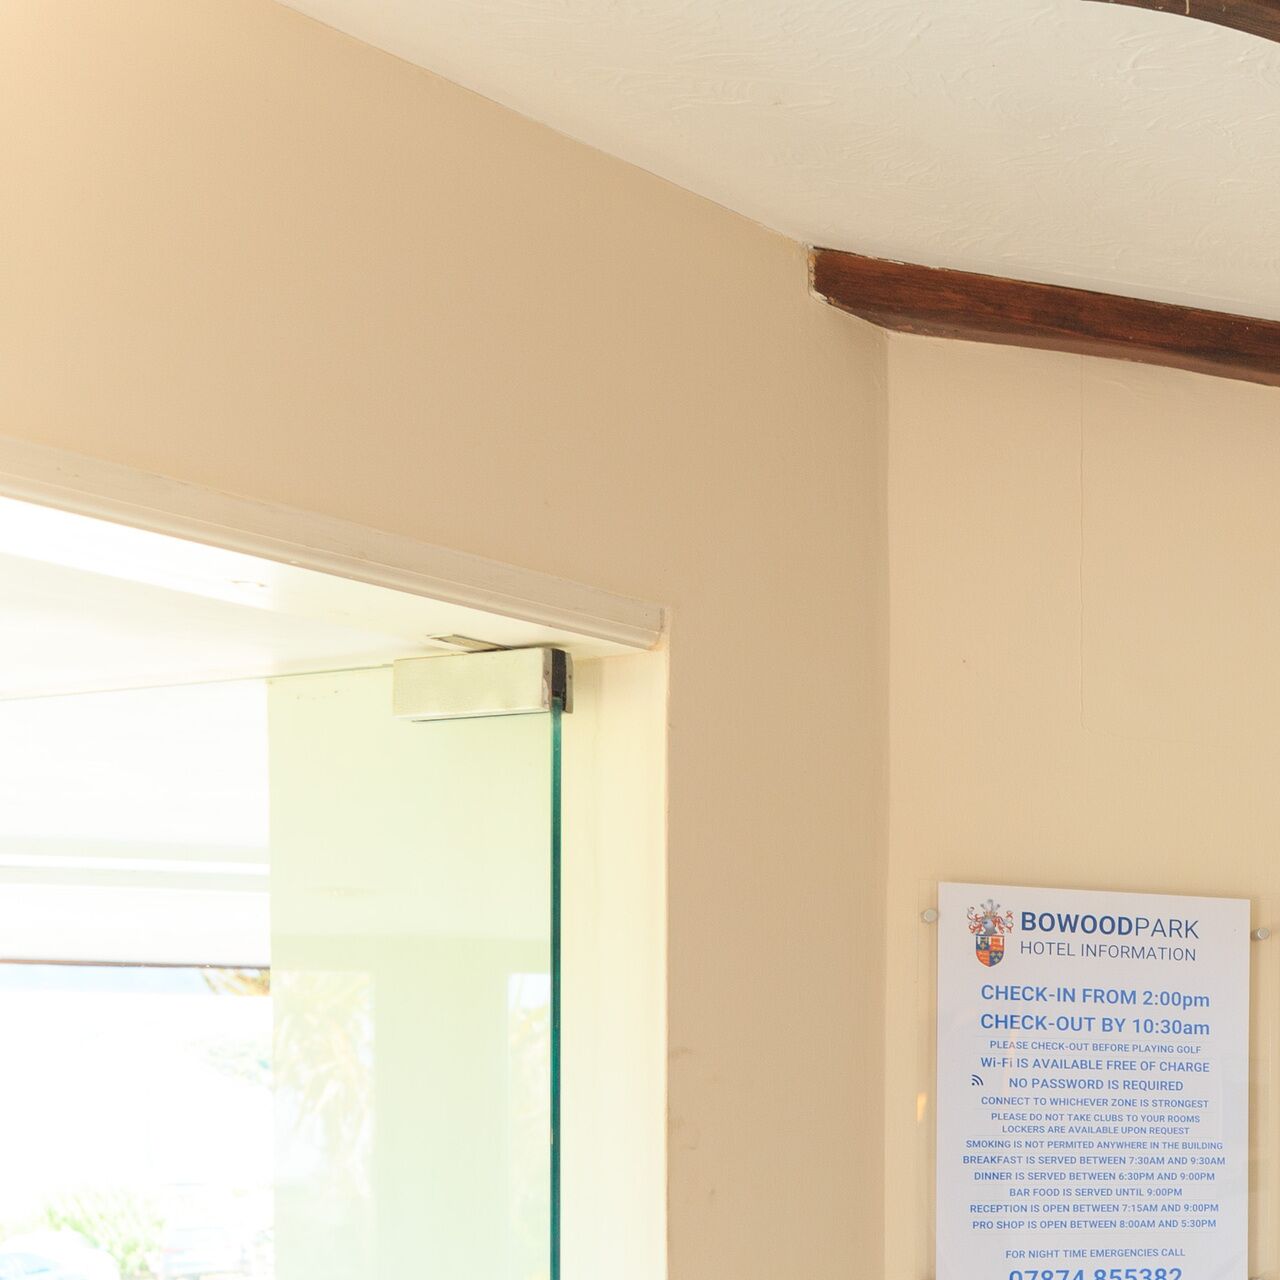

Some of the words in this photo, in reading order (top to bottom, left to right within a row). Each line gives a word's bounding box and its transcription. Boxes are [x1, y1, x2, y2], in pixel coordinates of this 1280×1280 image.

[1021, 911, 1199, 939] BOWOODPARK
[1020, 941, 1075, 957] HOTEL
[1081, 943, 1196, 961] INFORMATION
[981, 984, 1076, 1002] CHECK-IN
[1082, 988, 1137, 1005] FROM
[1142, 991, 1210, 1010] 2:00pm
[980, 1014, 1095, 1031] CHECK-OUT
[1102, 1018, 1126, 1032] BY
[1133, 1019, 1210, 1035] 10:30am
[990, 1040, 1028, 1049] PLEASE
[1031, 1041, 1089, 1050] CHECK-OUT
[1092, 1043, 1130, 1052] BEFORE
[1132, 1044, 1174, 1053] PLAYING
[1176, 1045, 1201, 1054] GOLF
[981, 1057, 1013, 1069] Wi-Fi
[1016, 1058, 1029, 1069] IS
[1032, 1059, 1102, 1070] AVAILABLE
[1106, 1060, 1136, 1070] FREE
[1140, 1061, 1156, 1071] OF
[1159, 1061, 1210, 1072] CHARGE
[1009, 1078, 1027, 1088] NO
[1031, 1078, 1103, 1089] PASSWORD
[1108, 1079, 1119, 1089] IS
[1123, 1080, 1183, 1091] REQUIRED
[981, 1096, 1029, 1105] CONNECT
[1034, 1097, 1047, 1105] TO
[1050, 1097, 1108, 1107] WHICHEVER
[1111, 1098, 1137, 1107] ZONE
[1140, 1099, 1149, 1107] IS
[1152, 1099, 1209, 1108] STRONGEST
[991, 1112, 1027, 1121] PLEASE
[1029, 1113, 1043, 1121] DO
[1045, 1113, 1064, 1121] NOT
[1067, 1114, 1091, 1122] TAKE
[1093, 1114, 1123, 1122] CLUBS
[1126, 1114, 1138, 1122] TO
[1141, 1114, 1165, 1123] YOUR
[1168, 1115, 1200, 1123] ROOMS
[1002, 1125, 1045, 1134] LOCKERS
[1047, 1125, 1066, 1134] ARE
[1068, 1126, 1118, 1134] AVAILABLE
[1121, 1126, 1147, 1135] UPON
[1149, 1127, 1190, 1135] REQUEST
[966, 1140, 1011, 1149] SMOKING
[1014, 1140, 1022, 1149] IS
[1025, 1140, 1045, 1149] NOT
[1047, 1141, 1095, 1149] PERMITED
[1097, 1141, 1148, 1149] ANYWHERE
[1150, 1142, 1159, 1150] IN
[1162, 1142, 1179, 1150] THE
[1181, 1142, 1223, 1150] BUILDING
[963, 1156, 1022, 1165] BREAKFAST
[1026, 1156, 1036, 1165] IS
[1038, 1156, 1077, 1165] SERVED
[1079, 1156, 1126, 1165] BETWEEN
[1129, 1156, 1165, 1165] 7:30AM
[1167, 1156, 1188, 1165] AND
[1191, 1156, 1226, 1165] 9:30AM
[974, 1172, 1012, 1181] DINNER
[1015, 1172, 1025, 1181] IS
[1028, 1172, 1066, 1181] SERVED
[1069, 1172, 1116, 1181] BETWEEN
[1119, 1172, 1155, 1181] 6:30PM
[1157, 1172, 1177, 1181] AND
[1180, 1172, 1215, 1181] 9:00PM
[1009, 1188, 1030, 1197] BAR
[1033, 1188, 1060, 1197] FOOD
[1063, 1188, 1072, 1197] IS
[1075, 1188, 1113, 1197] SERVED
[1116, 1188, 1144, 1197] UNTIL
[1147, 1188, 1183, 1197] 9:00PM
[970, 1204, 1028, 1213] RECEPTION
[1030, 1204, 1039, 1213] IS
[1043, 1204, 1070, 1213] OPEN
[1073, 1204, 1120, 1213] BETWEEN
[1122, 1204, 1158, 1213] 7:15AM
[1160, 1204, 1181, 1212] AND
[1183, 1204, 1219, 1212] 9:00PM
[973, 1221, 994, 1230] PRO
[996, 1221, 1025, 1229] SHOP
[1028, 1220, 1037, 1229] IS
[1039, 1220, 1067, 1229] OPEN
[1070, 1220, 1117, 1228] BETWEEN
[1120, 1220, 1156, 1228] 8:00AM
[1158, 1220, 1178, 1228] AND
[1181, 1219, 1217, 1228] 5:30PM
[1005, 1250, 1025, 1259] FOR
[1028, 1250, 1060, 1259] NIGHT
[1064, 1249, 1087, 1258] TIME
[1090, 1249, 1159, 1258] EMERGENCIES
[1161, 1248, 1185, 1257] CALL
